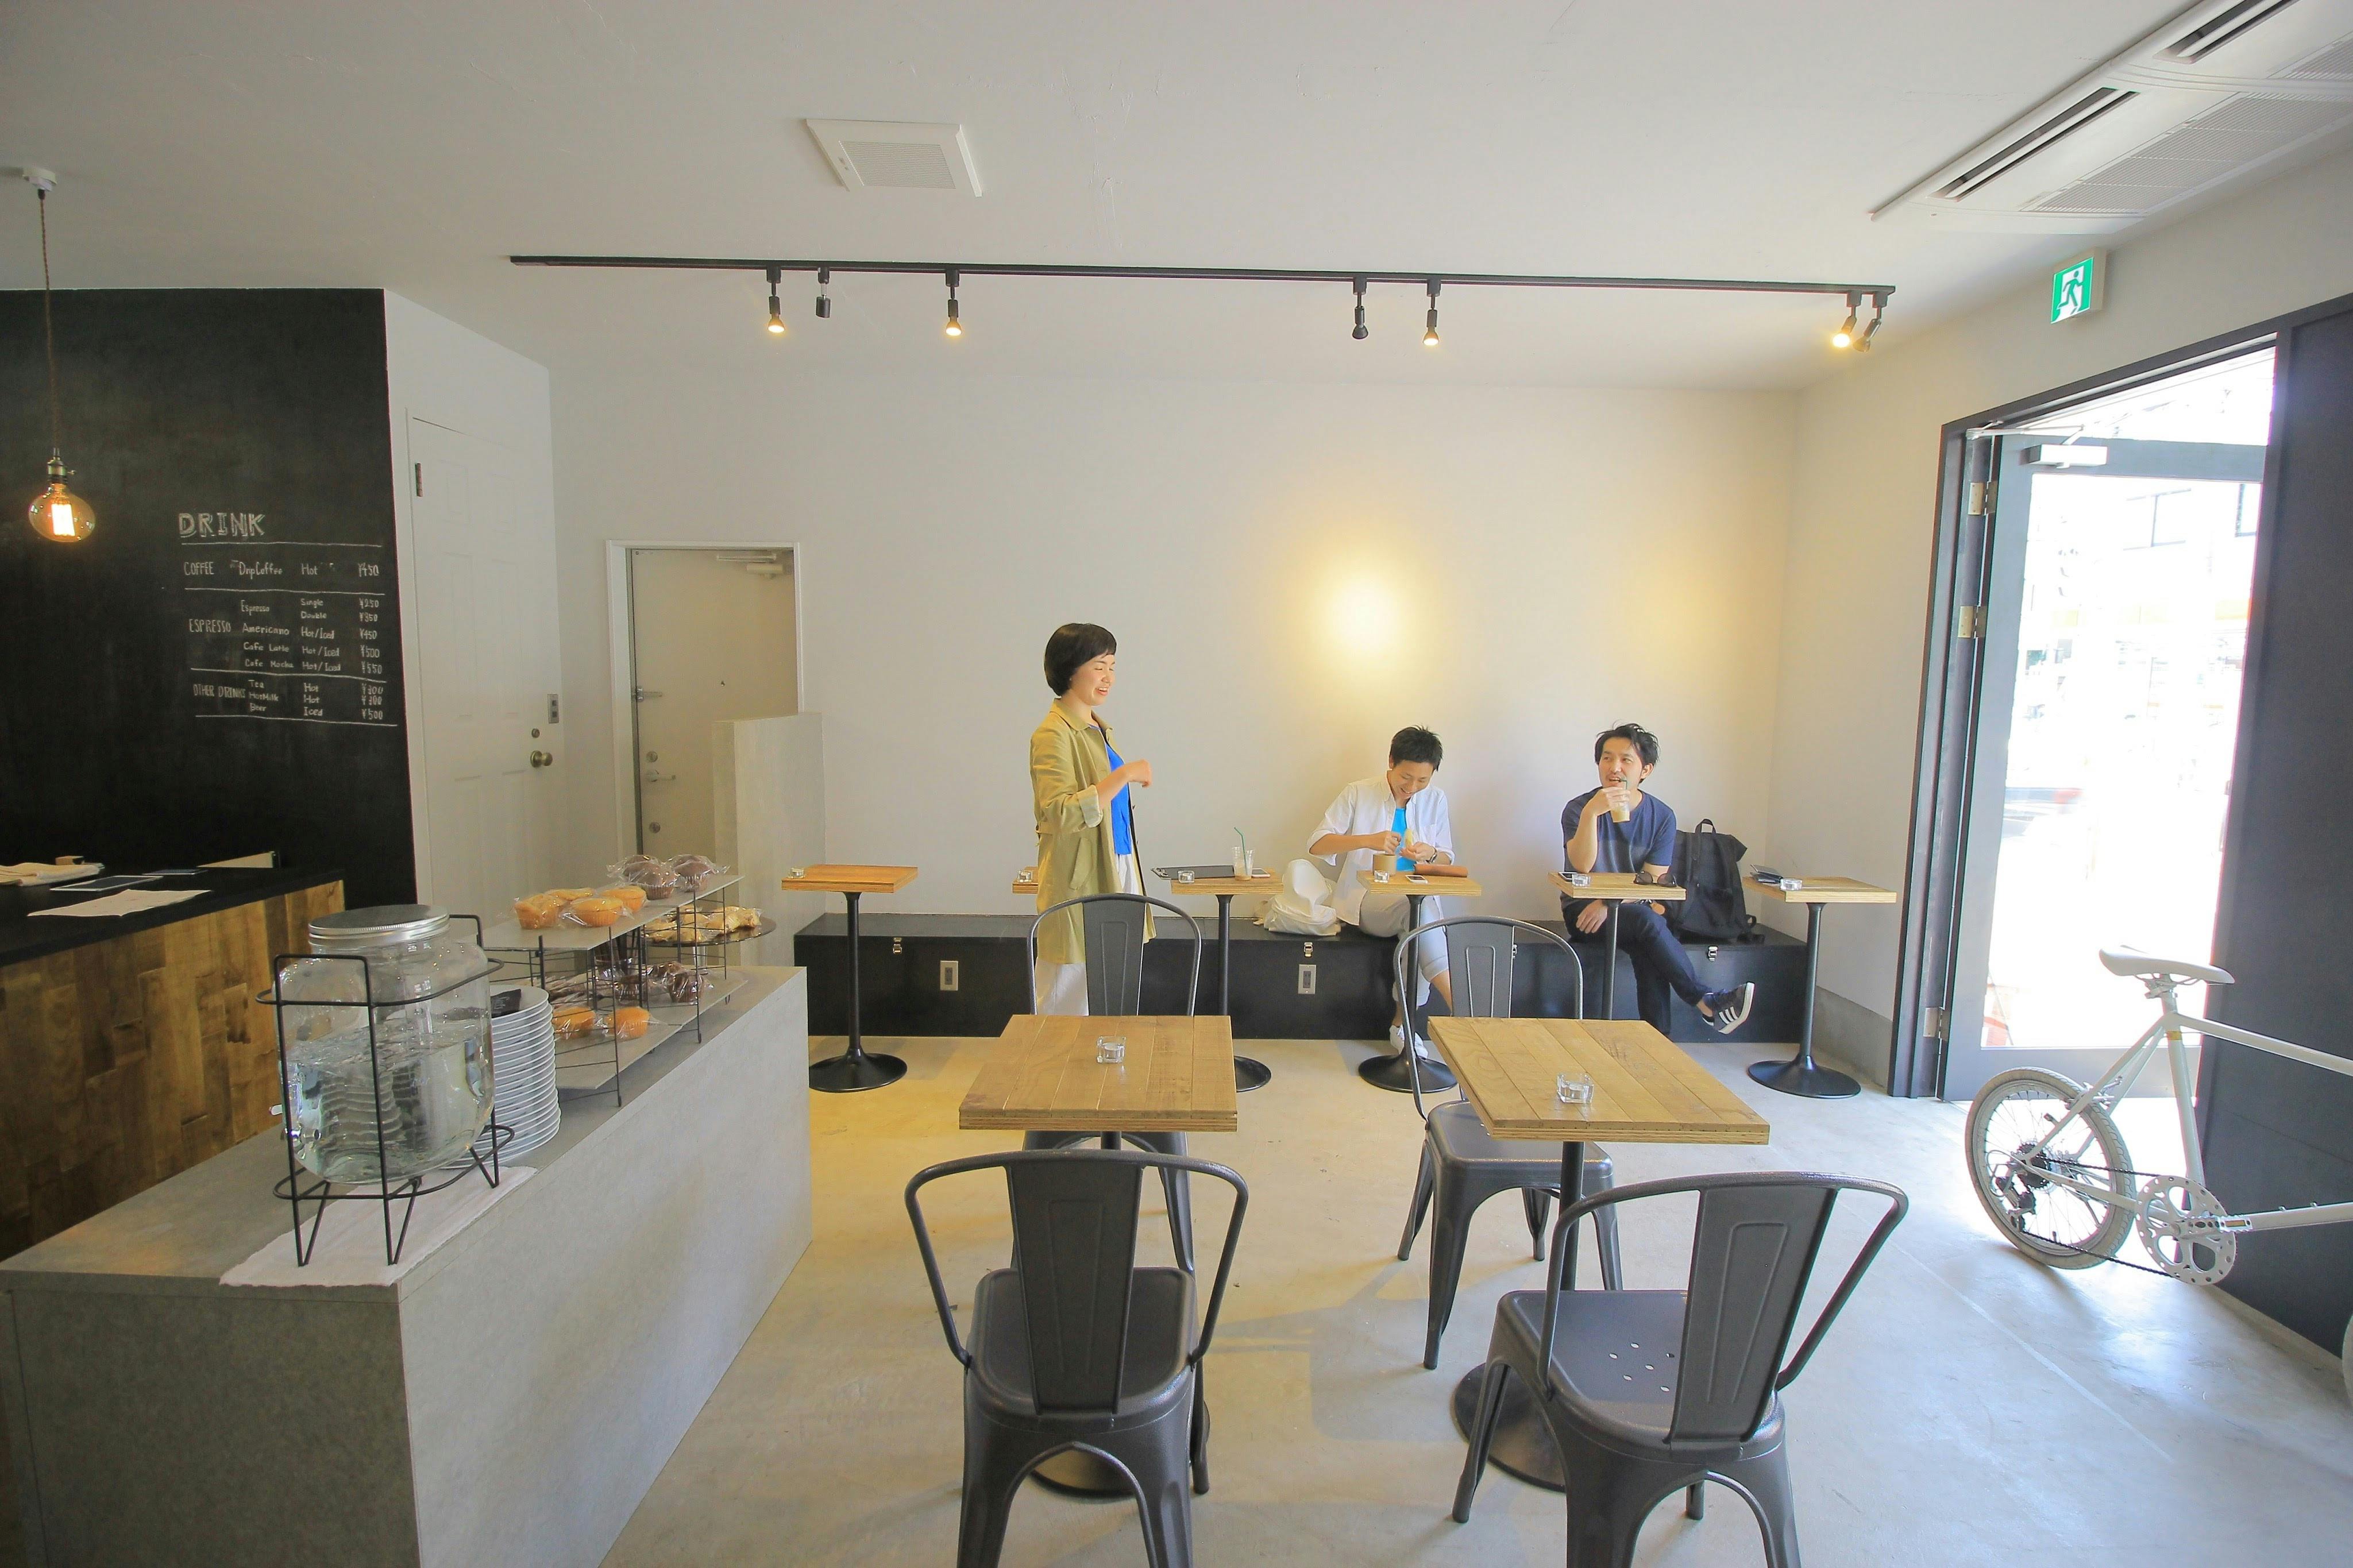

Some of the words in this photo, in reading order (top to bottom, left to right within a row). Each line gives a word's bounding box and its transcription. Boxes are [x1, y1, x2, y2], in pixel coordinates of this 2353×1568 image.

[179, 512, 265, 538] DRINK
[184, 561, 215, 576] COFFEE
[301, 563, 318, 576] Hot
[358, 562, 380, 577] ¥450
[241, 600, 270, 616] Espresso
[300, 598, 323, 609] Single
[359, 598, 379, 609] ¥250
[300, 611, 327, 619] Double
[359, 612, 378, 622] ¥350
[189, 619, 232, 633] ESPRESSO
[242, 623, 290, 635] Americano
[244, 642, 264, 651] Cafe
[269, 643, 290, 652] Latte
[360, 644, 380, 658] ¥500
[245, 659, 264, 667] Cafe
[270, 661, 294, 669] Mocha
[361, 661, 382, 674] ¥550
[193, 683, 215, 697] OTHER
[218, 686, 246, 698] DRINKS
[248, 679, 264, 689] Tea
[304, 682, 319, 693] Hot
[303, 694, 320, 704] Hot
[249, 702, 267, 712] Beer
[303, 706, 323, 716] Iced
[361, 708, 383, 720] ¥500
